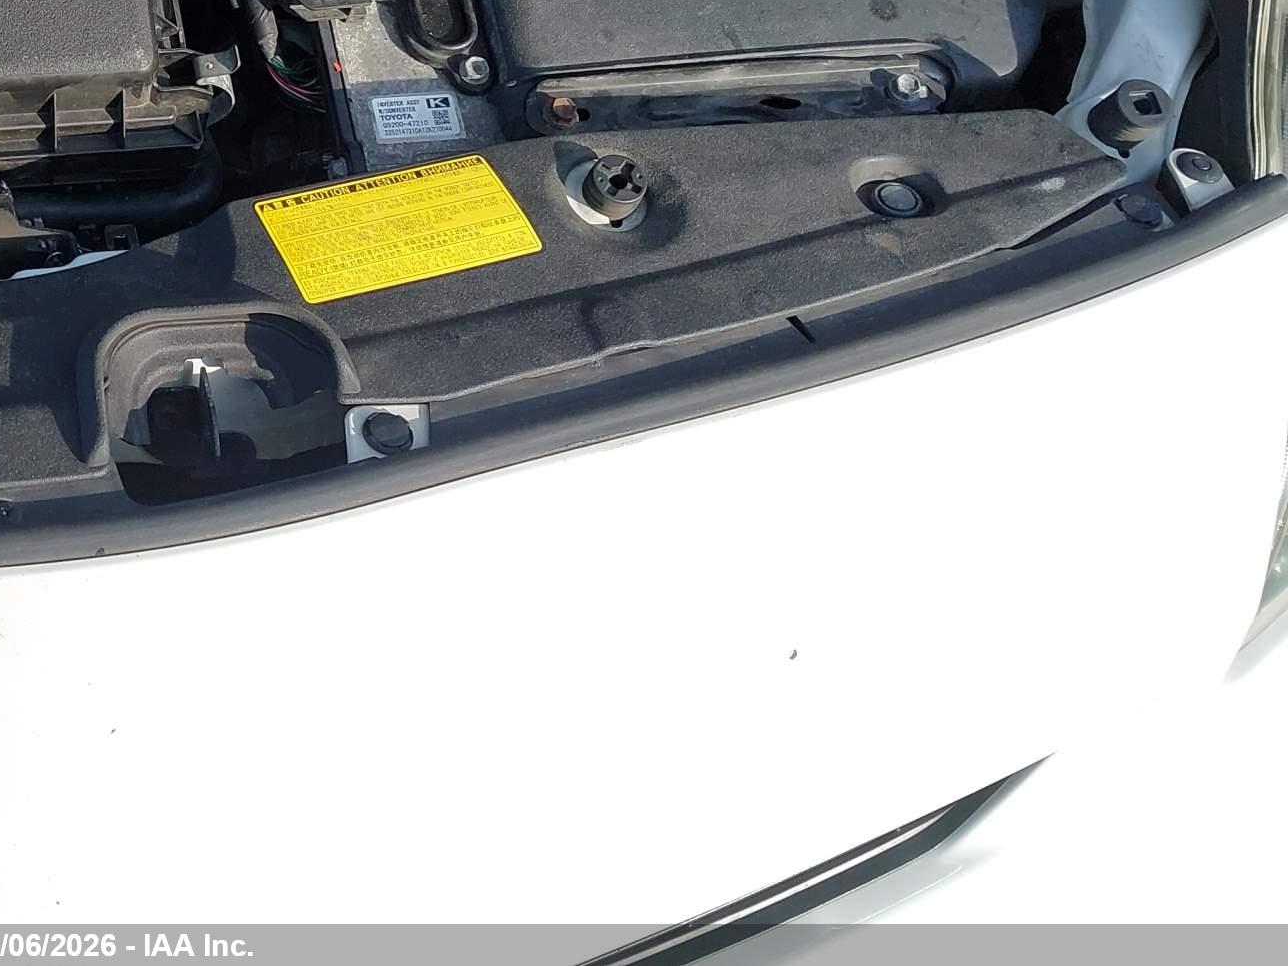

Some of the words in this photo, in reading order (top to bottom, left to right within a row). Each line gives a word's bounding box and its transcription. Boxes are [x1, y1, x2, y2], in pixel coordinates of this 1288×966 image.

[380, 113, 414, 121] TOYOTA
[300, 186, 351, 203] CAUTION
[355, 170, 418, 192] ATTENTION
[421, 158, 482, 176] ВНИМАНИЕ
